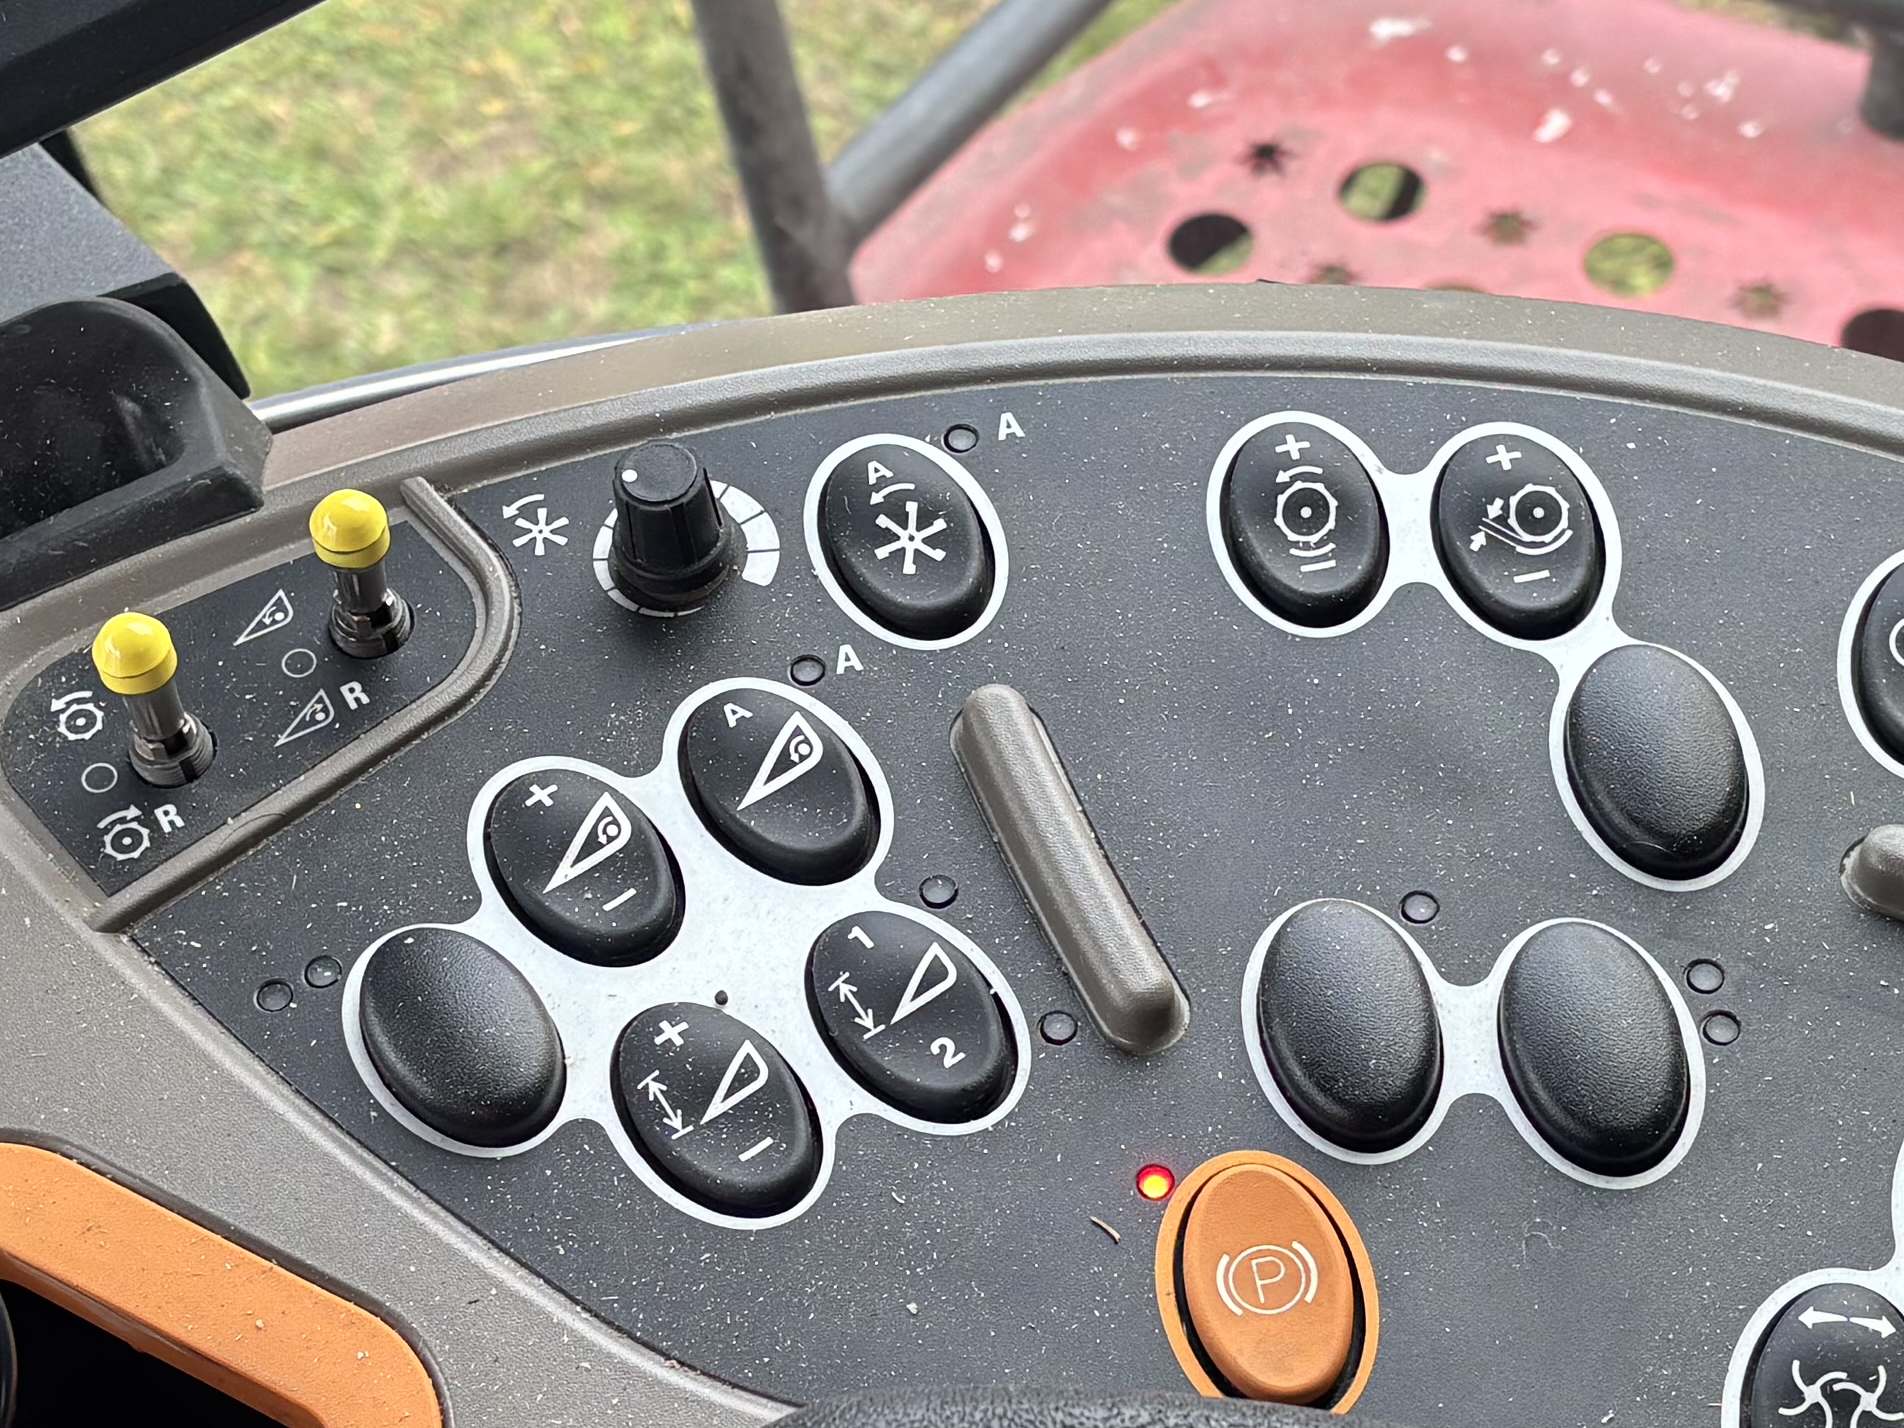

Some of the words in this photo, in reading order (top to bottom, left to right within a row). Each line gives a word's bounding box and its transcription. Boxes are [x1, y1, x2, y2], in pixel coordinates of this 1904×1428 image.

[997, 411, 1028, 442] A
[866, 460, 896, 486] A
[835, 643, 866, 675] A
[339, 680, 371, 712] R
[723, 702, 754, 729] A
[153, 802, 186, 835] R
[847, 924, 876, 950] 1
[929, 1036, 968, 1070] 2
[1250, 1255, 1287, 1304] P
